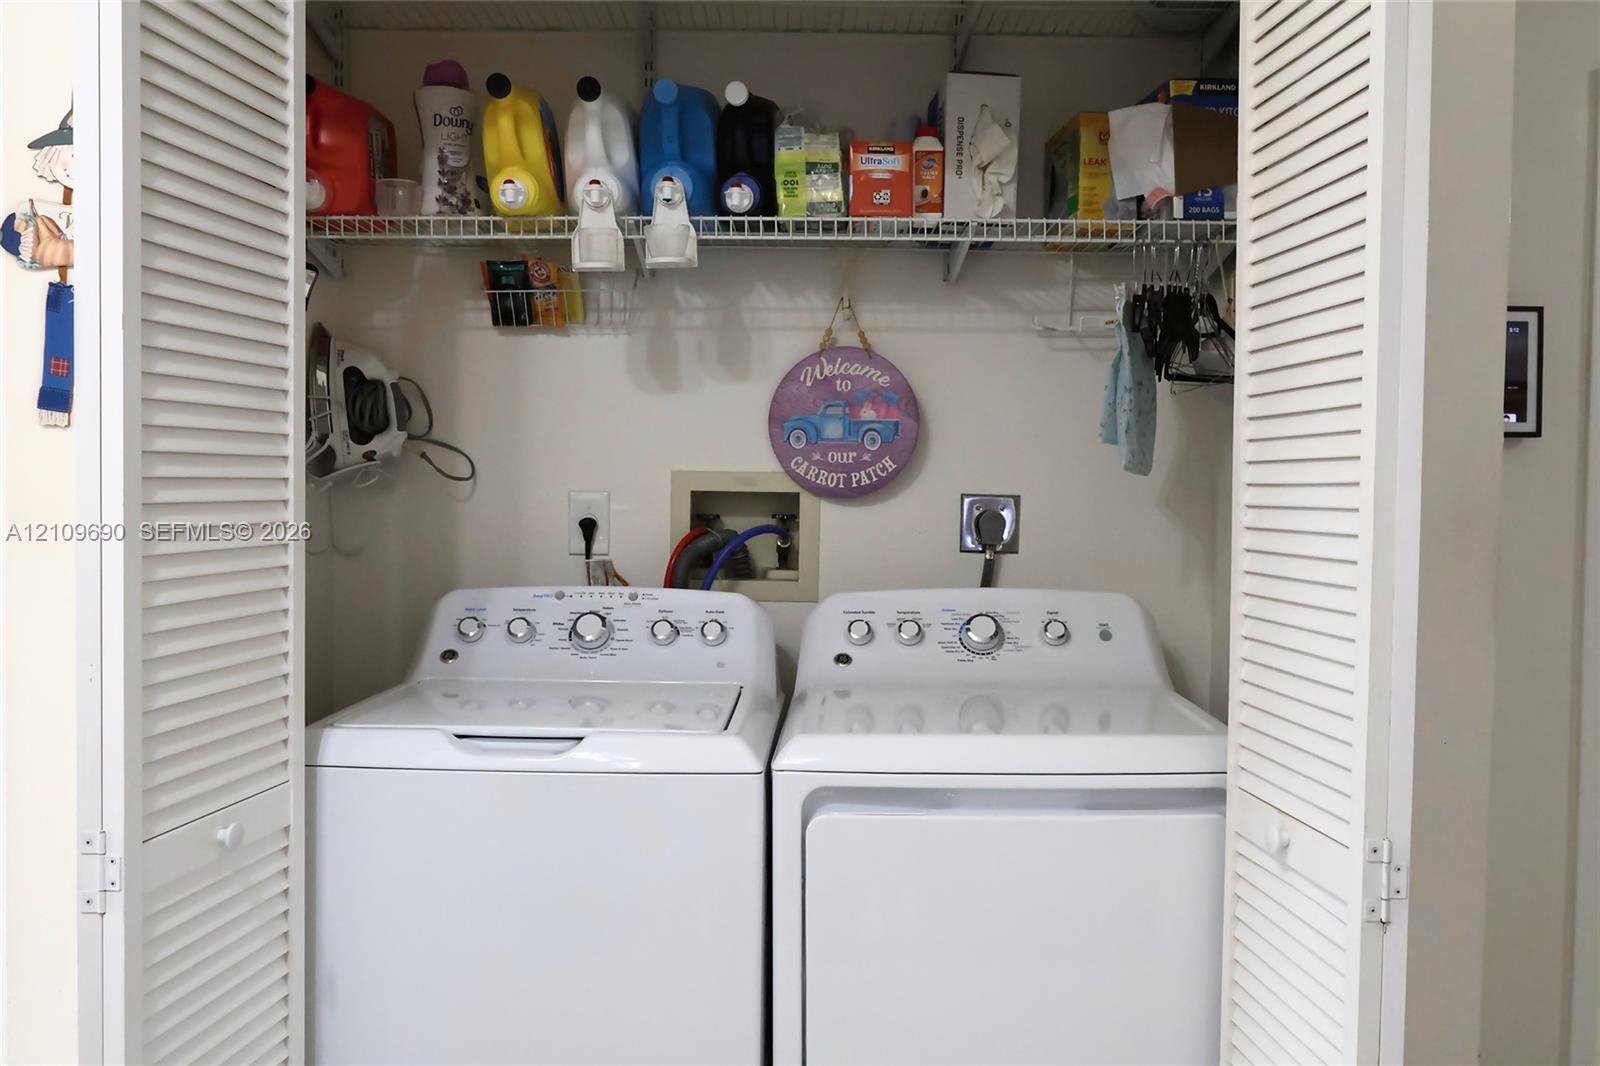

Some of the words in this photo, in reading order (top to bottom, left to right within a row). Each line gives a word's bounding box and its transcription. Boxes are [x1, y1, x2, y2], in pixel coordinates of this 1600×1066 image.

[433, 113, 474, 135] Downy
[956, 116, 965, 157] DISPENSE
[860, 156, 900, 166] UltraSoft
[1083, 157, 1107, 166] LEAK
[800, 356, 890, 387] Welcome
[836, 379, 851, 391] to
[828, 451, 857, 464] our
[790, 456, 847, 488] CARROT
[851, 455, 897, 487] PATCH
